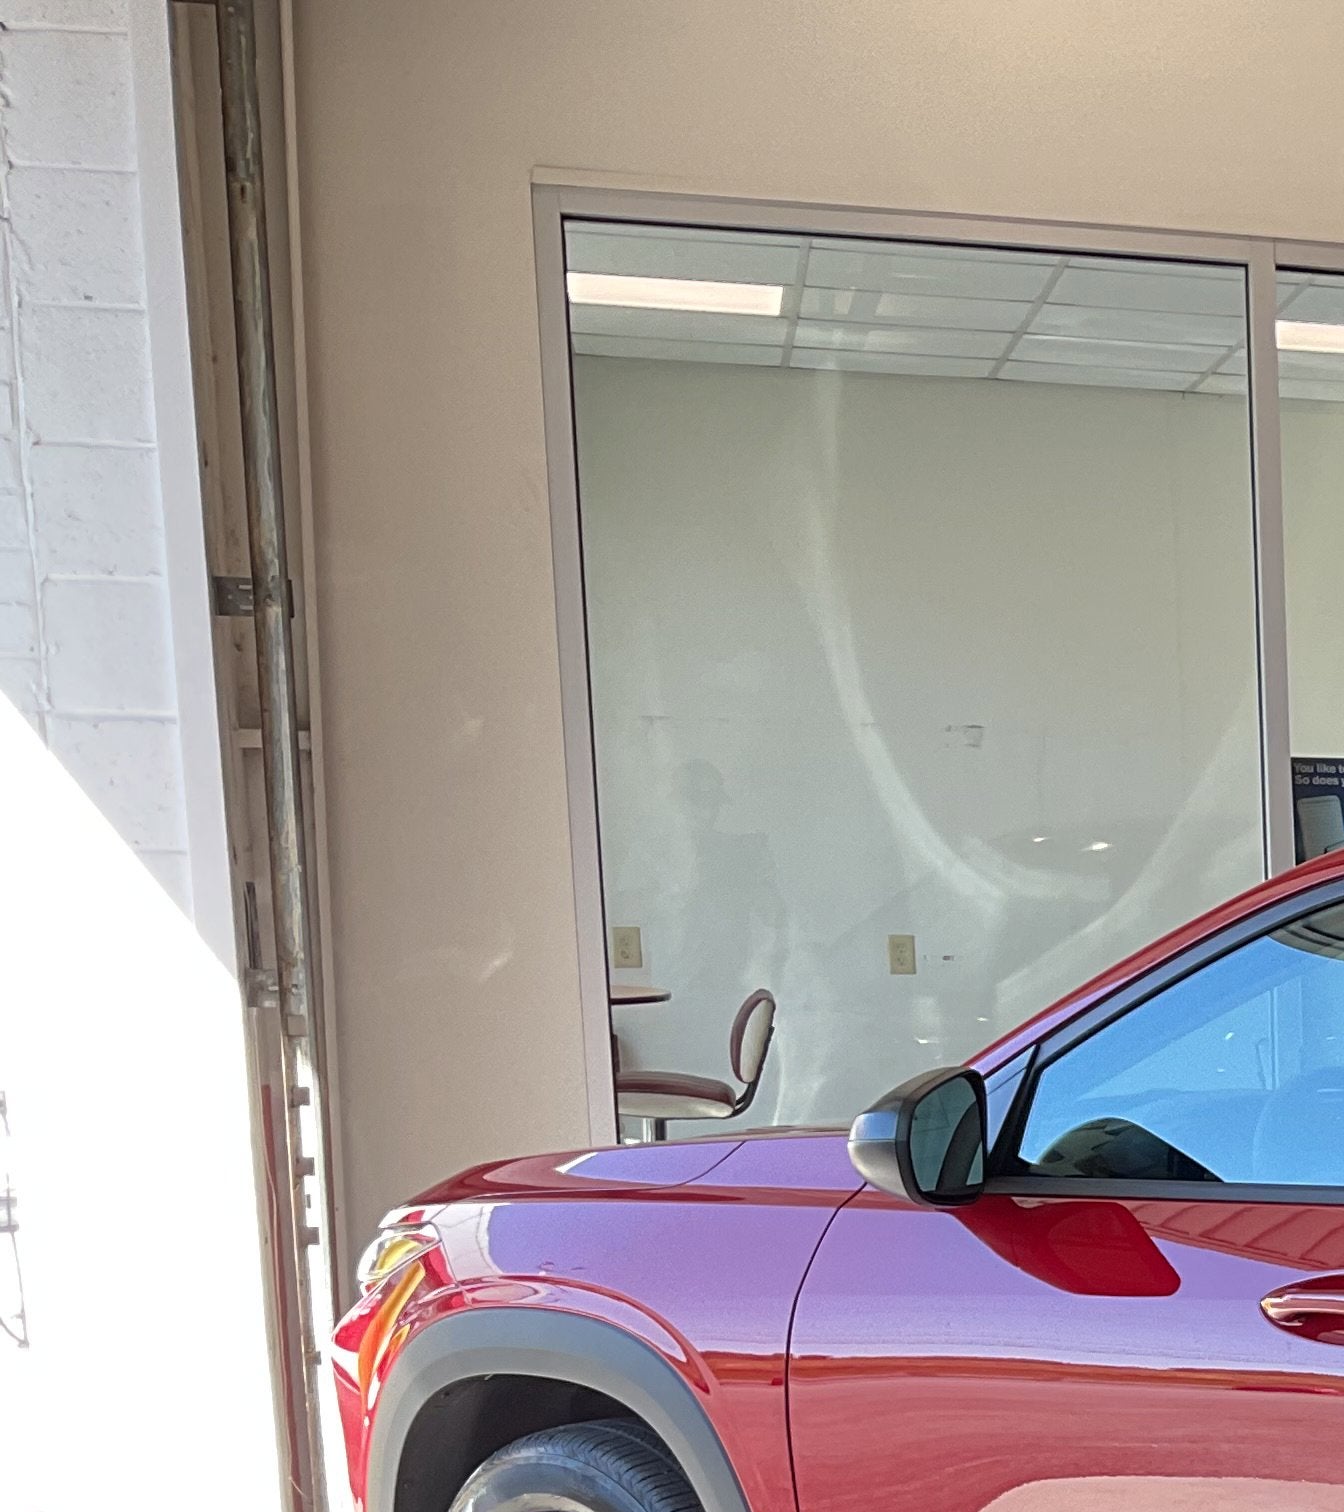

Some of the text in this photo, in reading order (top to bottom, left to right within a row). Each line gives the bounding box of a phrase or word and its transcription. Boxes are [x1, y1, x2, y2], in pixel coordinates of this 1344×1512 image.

[1294, 762, 1314, 774] You
[1316, 763, 1337, 775] like
[1294, 775, 1311, 785] So
[1312, 775, 1339, 786] does
